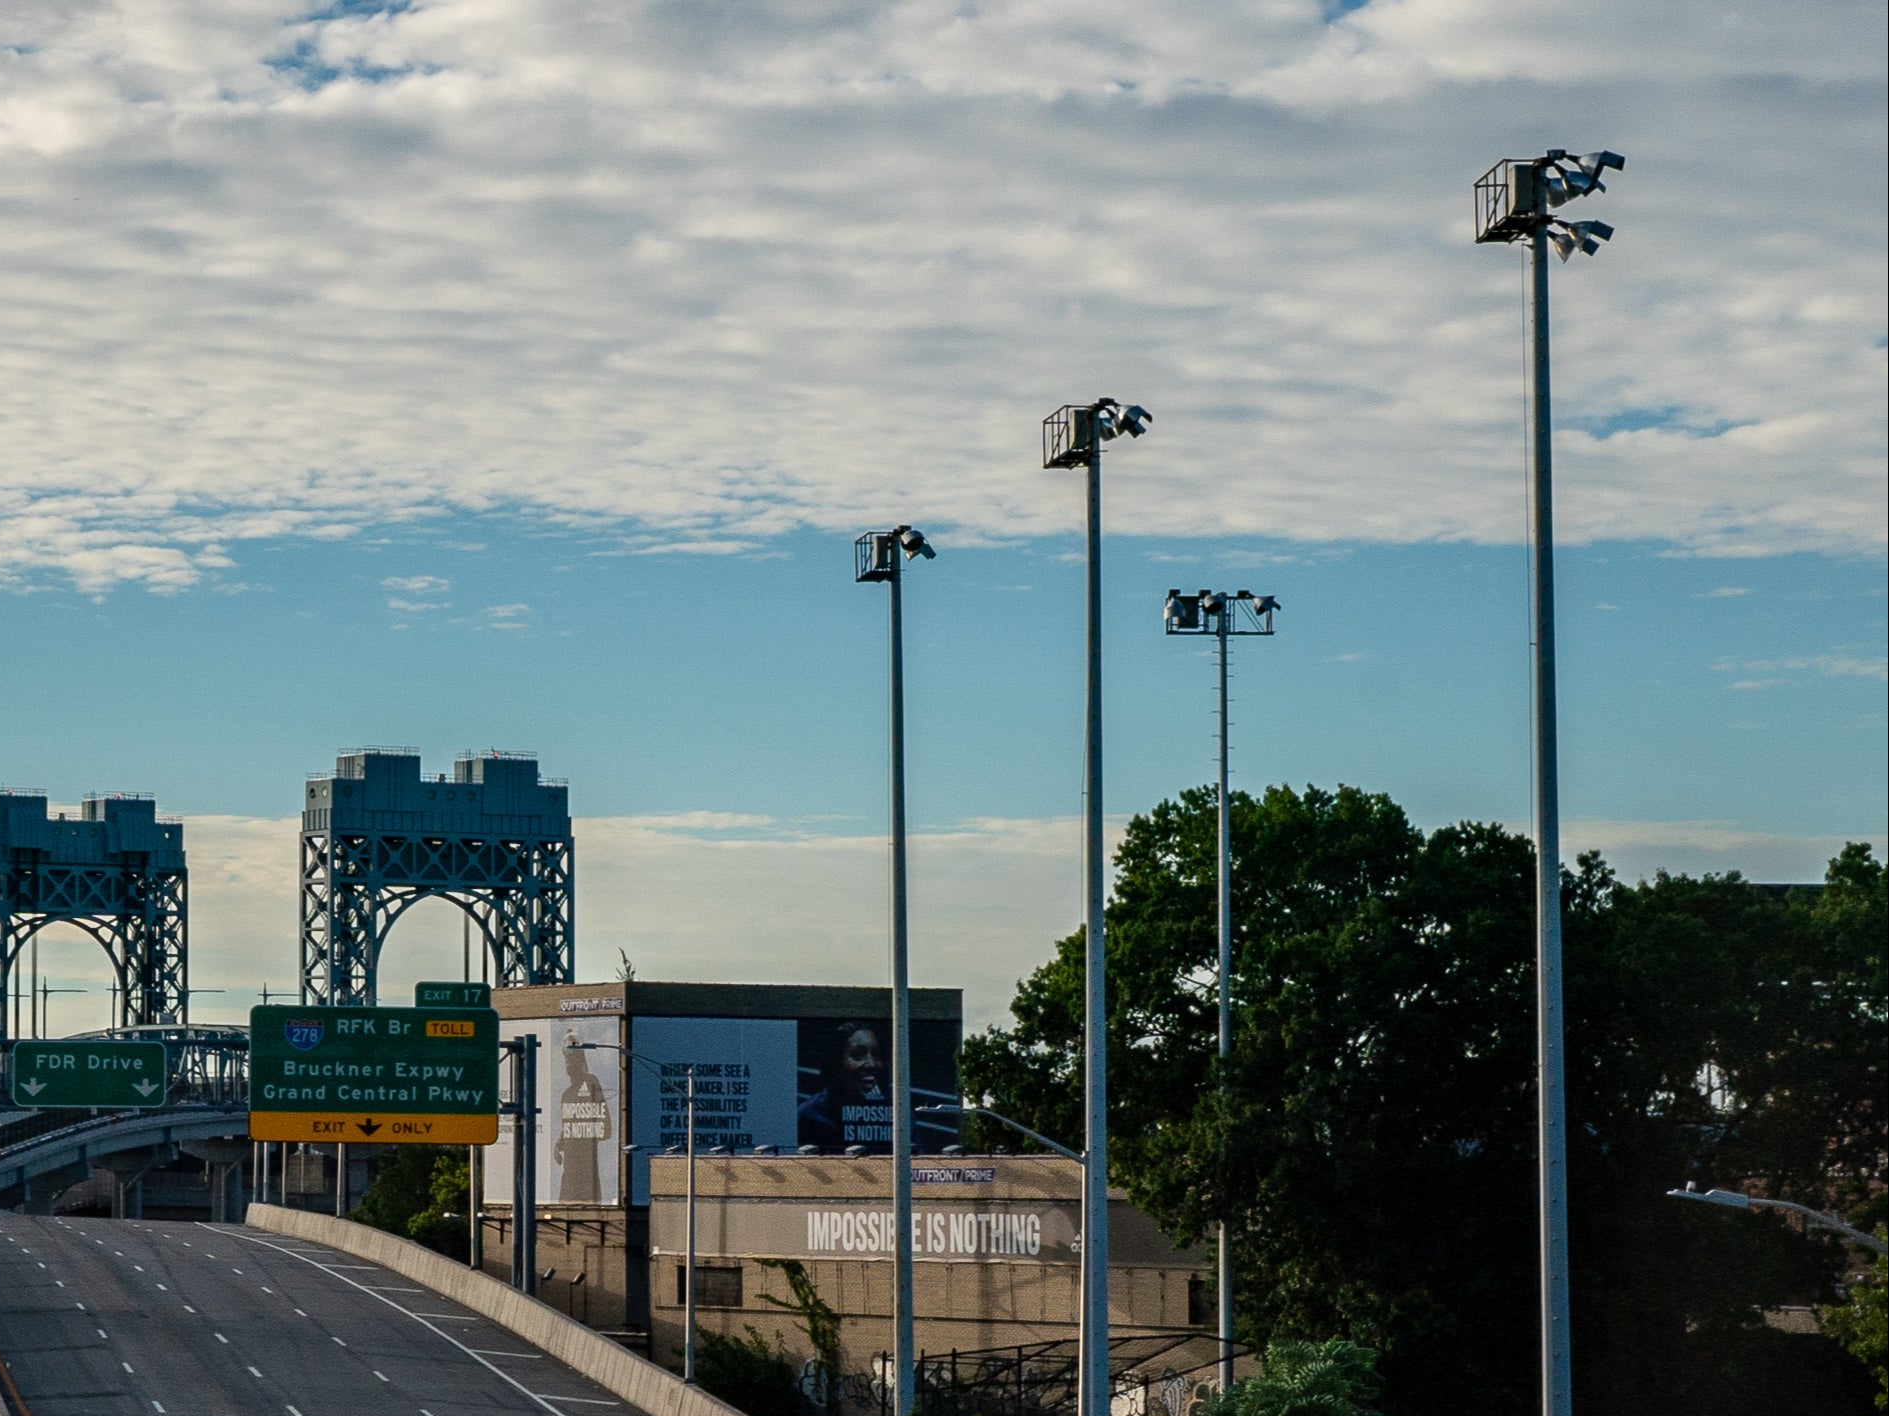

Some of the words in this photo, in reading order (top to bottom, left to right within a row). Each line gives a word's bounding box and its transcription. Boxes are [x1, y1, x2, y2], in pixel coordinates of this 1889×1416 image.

[424, 990, 451, 1001] EXIT
[464, 989, 482, 1003] 17
[337, 1019, 376, 1035] RFK
[388, 1020, 411, 1035] Br
[431, 1023, 468, 1035] TOLL
[291, 1028, 318, 1043] 278
[35, 1054, 75, 1069] FDR
[87, 1054, 144, 1070] Drive
[284, 1061, 384, 1077] Bruckner
[395, 1062, 464, 1081] Expwy
[695, 1063, 723, 1078] SOME
[724, 1064, 742, 1078] SEE
[743, 1064, 750, 1078] A
[263, 1084, 326, 1100] Grand
[337, 1085, 417, 1101] Central
[428, 1086, 484, 1105] Pkwy
[660, 1080, 687, 1094] GAME
[732, 1081, 750, 1095] SEE
[562, 1102, 606, 1119] IMPOSSIBLE
[660, 1098, 679, 1111] THE
[681, 1098, 747, 1112] PSSIBILITIES
[313, 1121, 345, 1133] EXIT
[392, 1122, 433, 1135] ONLY
[660, 1115, 673, 1129] OF
[674, 1115, 681, 1129] A
[683, 1115, 742, 1129] CMMUNITY
[563, 1122, 571, 1138] IS
[571, 1122, 605, 1138] NOTHING
[844, 1124, 855, 1141] IS
[660, 1132, 717, 1146] DIFFEENCE
[910, 1169, 959, 1181] UTFRONT
[964, 1169, 993, 1181] PRIME
[807, 1211, 922, 1251] IMPOSSIBE
[926, 1212, 946, 1252] IS
[950, 1213, 1041, 1256] NOTHING
